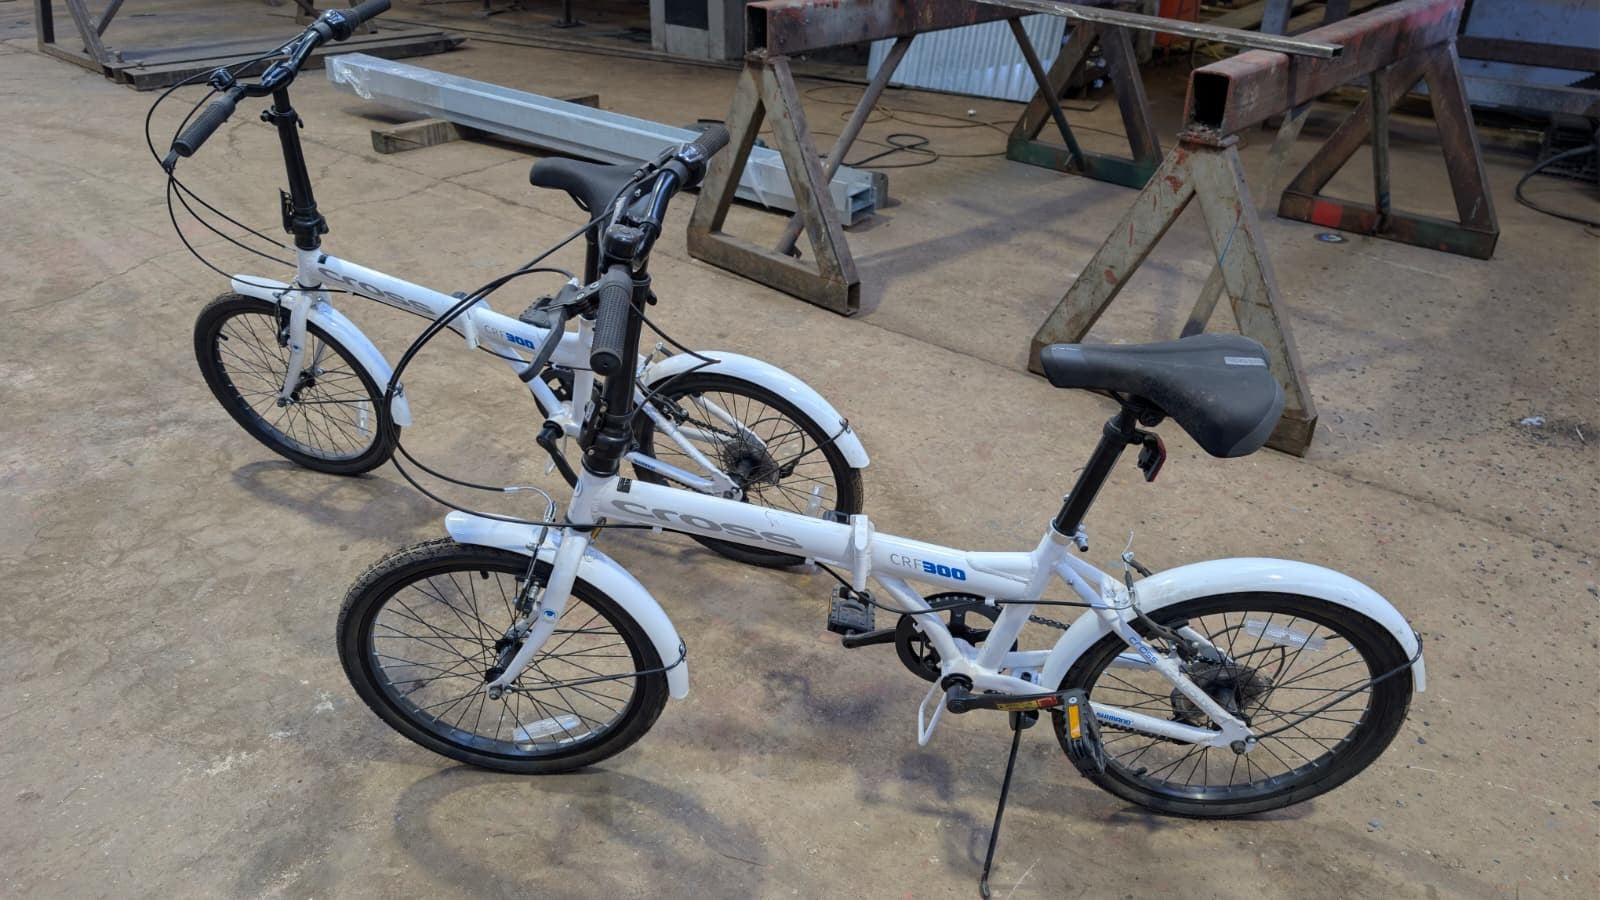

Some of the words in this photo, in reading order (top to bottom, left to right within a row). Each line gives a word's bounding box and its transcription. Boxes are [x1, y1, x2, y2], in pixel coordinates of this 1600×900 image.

[318, 268, 437, 315] cross
[611, 499, 803, 549] cross
[890, 553, 966, 581] CRF300
